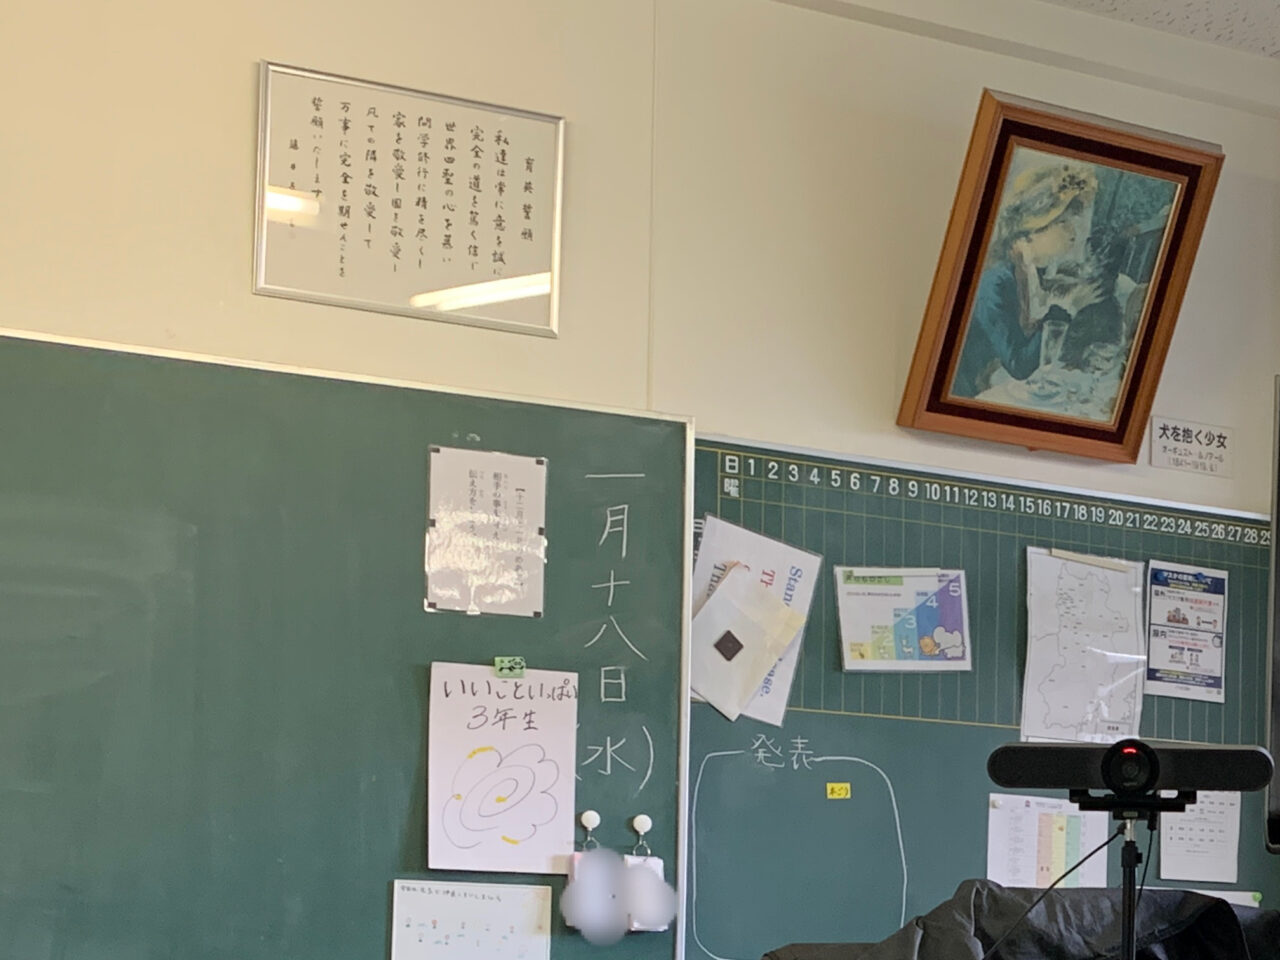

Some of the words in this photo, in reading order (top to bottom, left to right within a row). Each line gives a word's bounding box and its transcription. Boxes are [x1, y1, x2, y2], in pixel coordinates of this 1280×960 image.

[1158, 422, 1228, 450] 犬を抱く少女
[724, 455, 740, 475] 日
[748, 458, 756, 476] 1
[767, 461, 779, 479] 2
[788, 464, 799, 482] 3
[809, 467, 821, 485] 4
[830, 470, 842, 488] 5
[850, 473, 861, 490] 6
[870, 476, 881, 493] 7
[888, 478, 900, 496] 8
[908, 481, 919, 498] 9
[924, 483, 941, 500] 10
[944, 486, 960, 503] 11
[963, 489, 979, 506] 12
[980, 490, 997, 509] 13
[1000, 493, 1015, 512] 14
[1018, 496, 1035, 514] 15
[1037, 499, 1052, 516] 16
[1055, 502, 1070, 519] 17
[1073, 504, 1088, 521] 18
[1091, 507, 1105, 523] 19
[1108, 510, 1124, 526] 20
[1126, 512, 1140, 528] 21
[1143, 514, 1158, 531] 22
[1161, 517, 1176, 533] 23
[1177, 519, 1192, 535] 24
[1194, 521, 1210, 538] 25
[1211, 524, 1226, 540] 26
[1227, 526, 1242, 542] 27
[1244, 528, 1259, 544] 28
[584, 473, 649, 703] 一月十八日
[782, 564, 804, 608] Stan
[948, 582, 961, 596] 5
[925, 595, 939, 609] 4
[904, 614, 918, 629] 3
[442, 678, 579, 702] いいこといっぱい
[466, 704, 540, 732] 3年生
[750, 734, 814, 770] 発表
